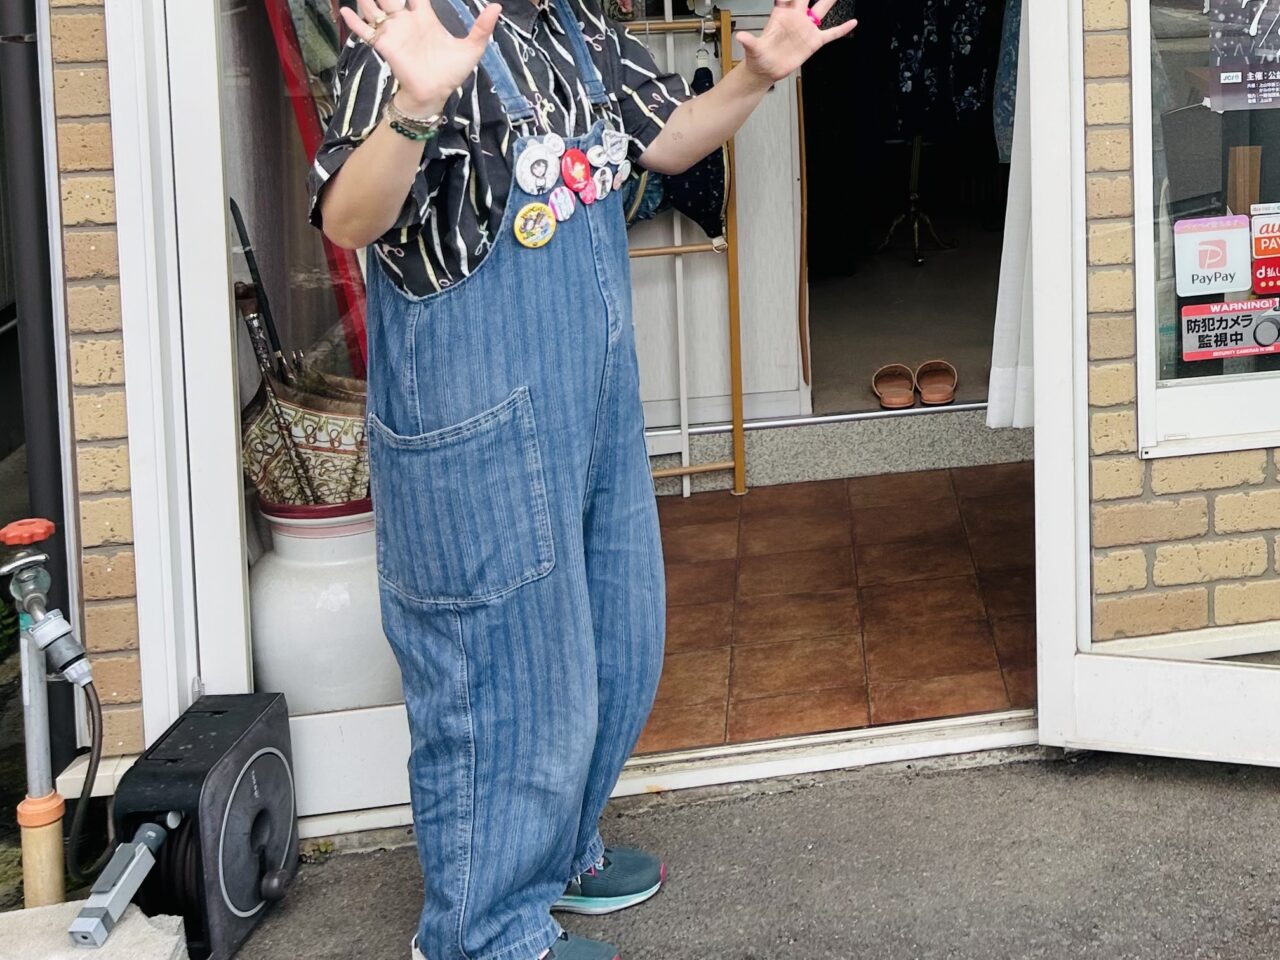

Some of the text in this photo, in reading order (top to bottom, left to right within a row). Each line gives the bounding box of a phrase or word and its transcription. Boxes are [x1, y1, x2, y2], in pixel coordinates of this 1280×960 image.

[1191, 271, 1237, 286] PayPay
[1210, 298, 1273, 313] WARNING!
[1186, 314, 1254, 335] 防犯カメラ
[1198, 331, 1244, 349] 監視中
